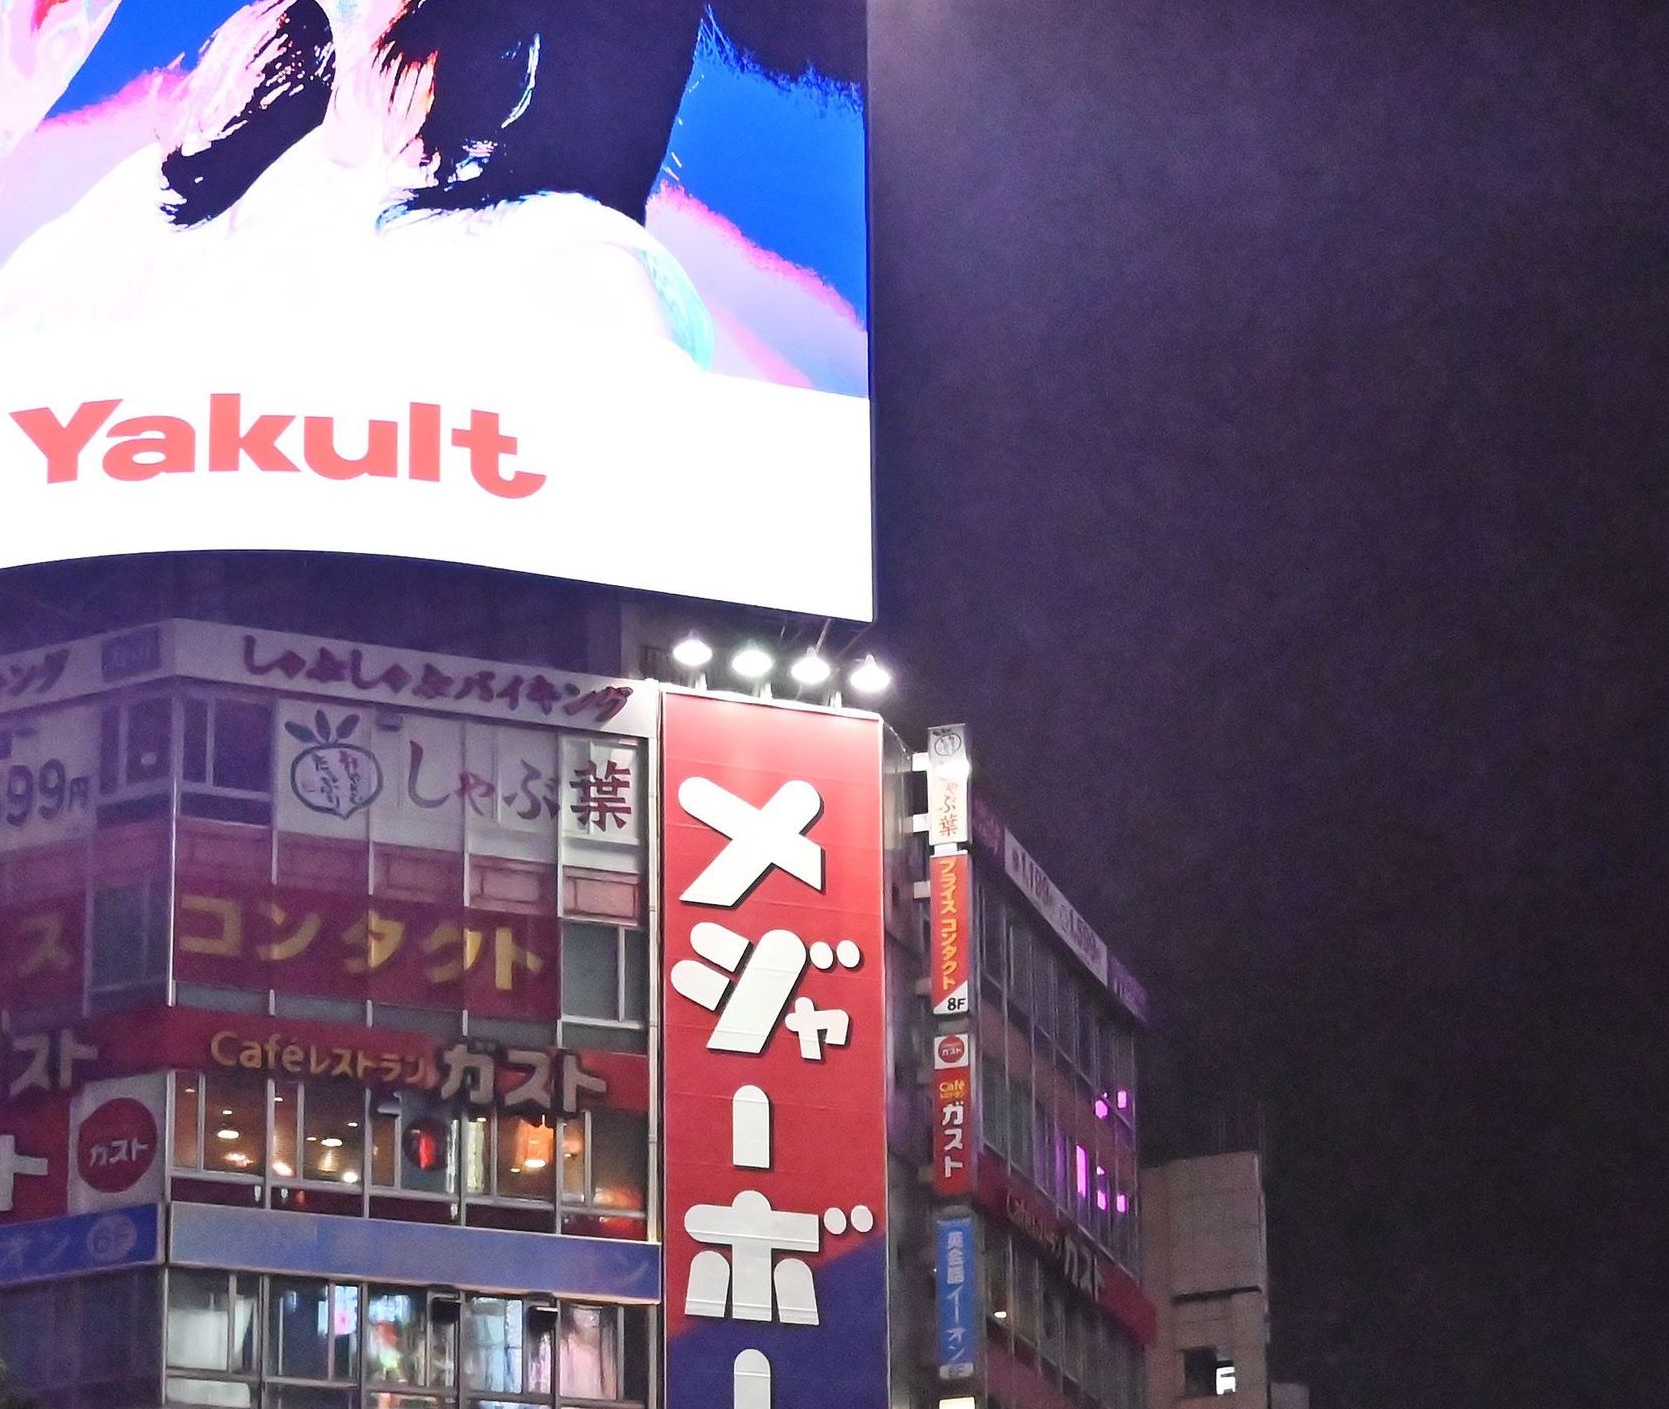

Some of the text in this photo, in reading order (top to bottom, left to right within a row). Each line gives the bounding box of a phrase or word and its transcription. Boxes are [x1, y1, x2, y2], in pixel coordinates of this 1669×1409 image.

[8, 392, 547, 500] Yakult
[407, 739, 632, 832] しゃぶ葉
[938, 774, 961, 838] ゃぶ葉
[180, 895, 544, 991] コンタクト
[946, 997, 966, 1012] 8F
[439, 1037, 608, 1113] ガスト
[88, 1137, 151, 1168] ガスト
[941, 1101, 964, 1178] ガスト
